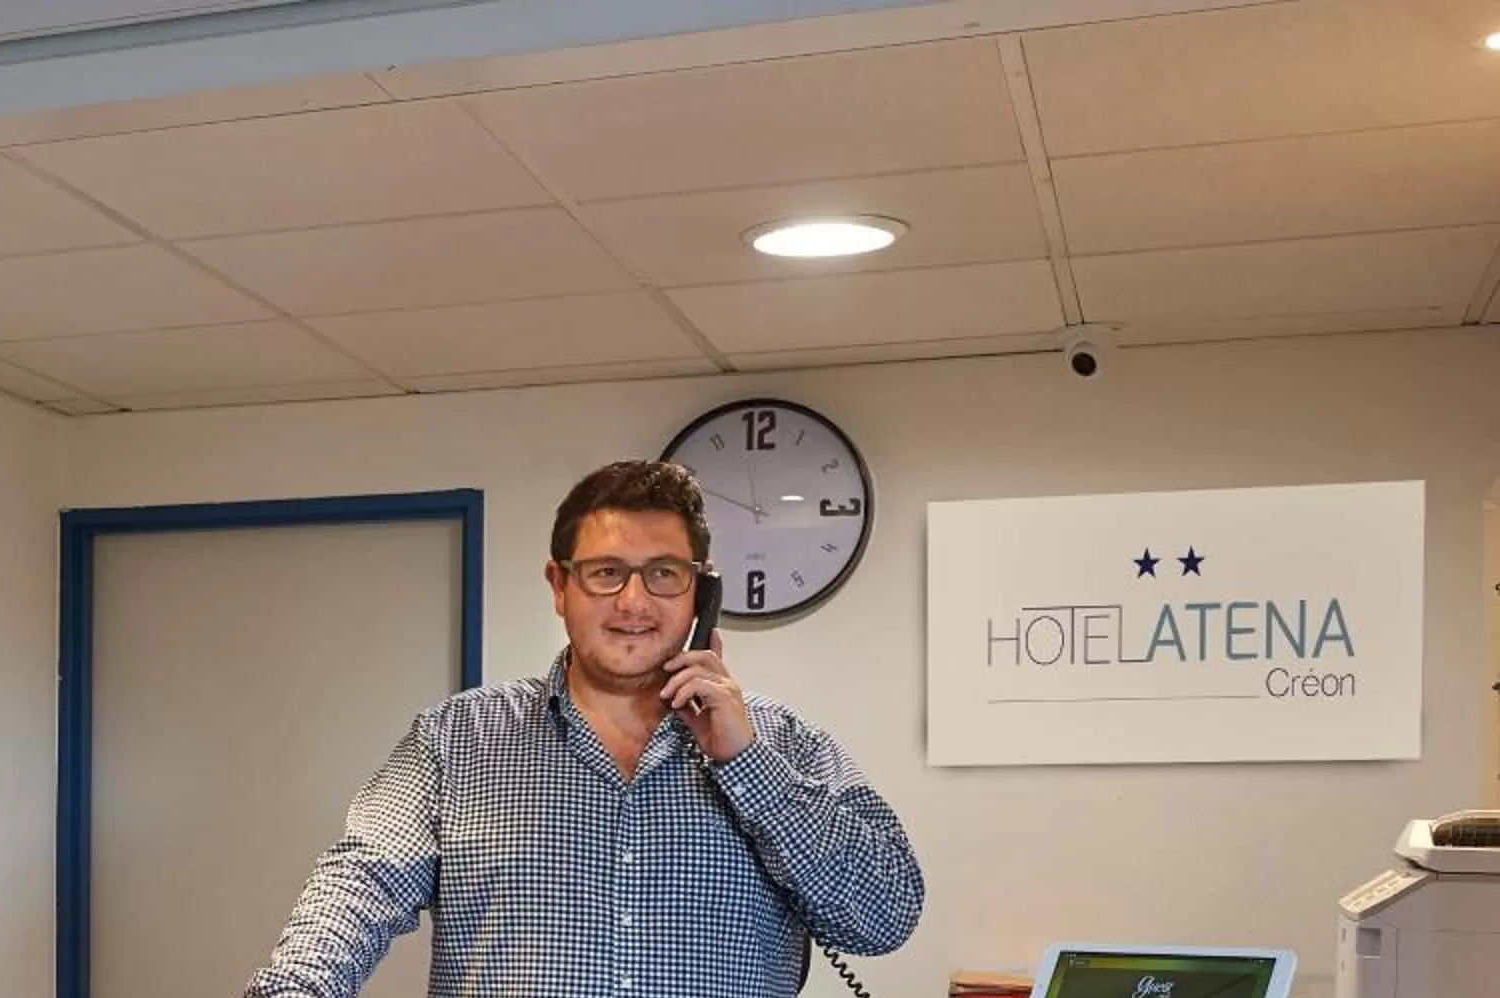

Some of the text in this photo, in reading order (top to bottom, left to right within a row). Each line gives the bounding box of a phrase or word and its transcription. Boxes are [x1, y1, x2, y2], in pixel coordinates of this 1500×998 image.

[709, 432, 725, 452] 11
[741, 409, 777, 451] 12
[821, 458, 840, 478] 2
[819, 497, 861, 517] 3
[746, 569, 766, 611] 6
[1265, 667, 1356, 699] Créon
